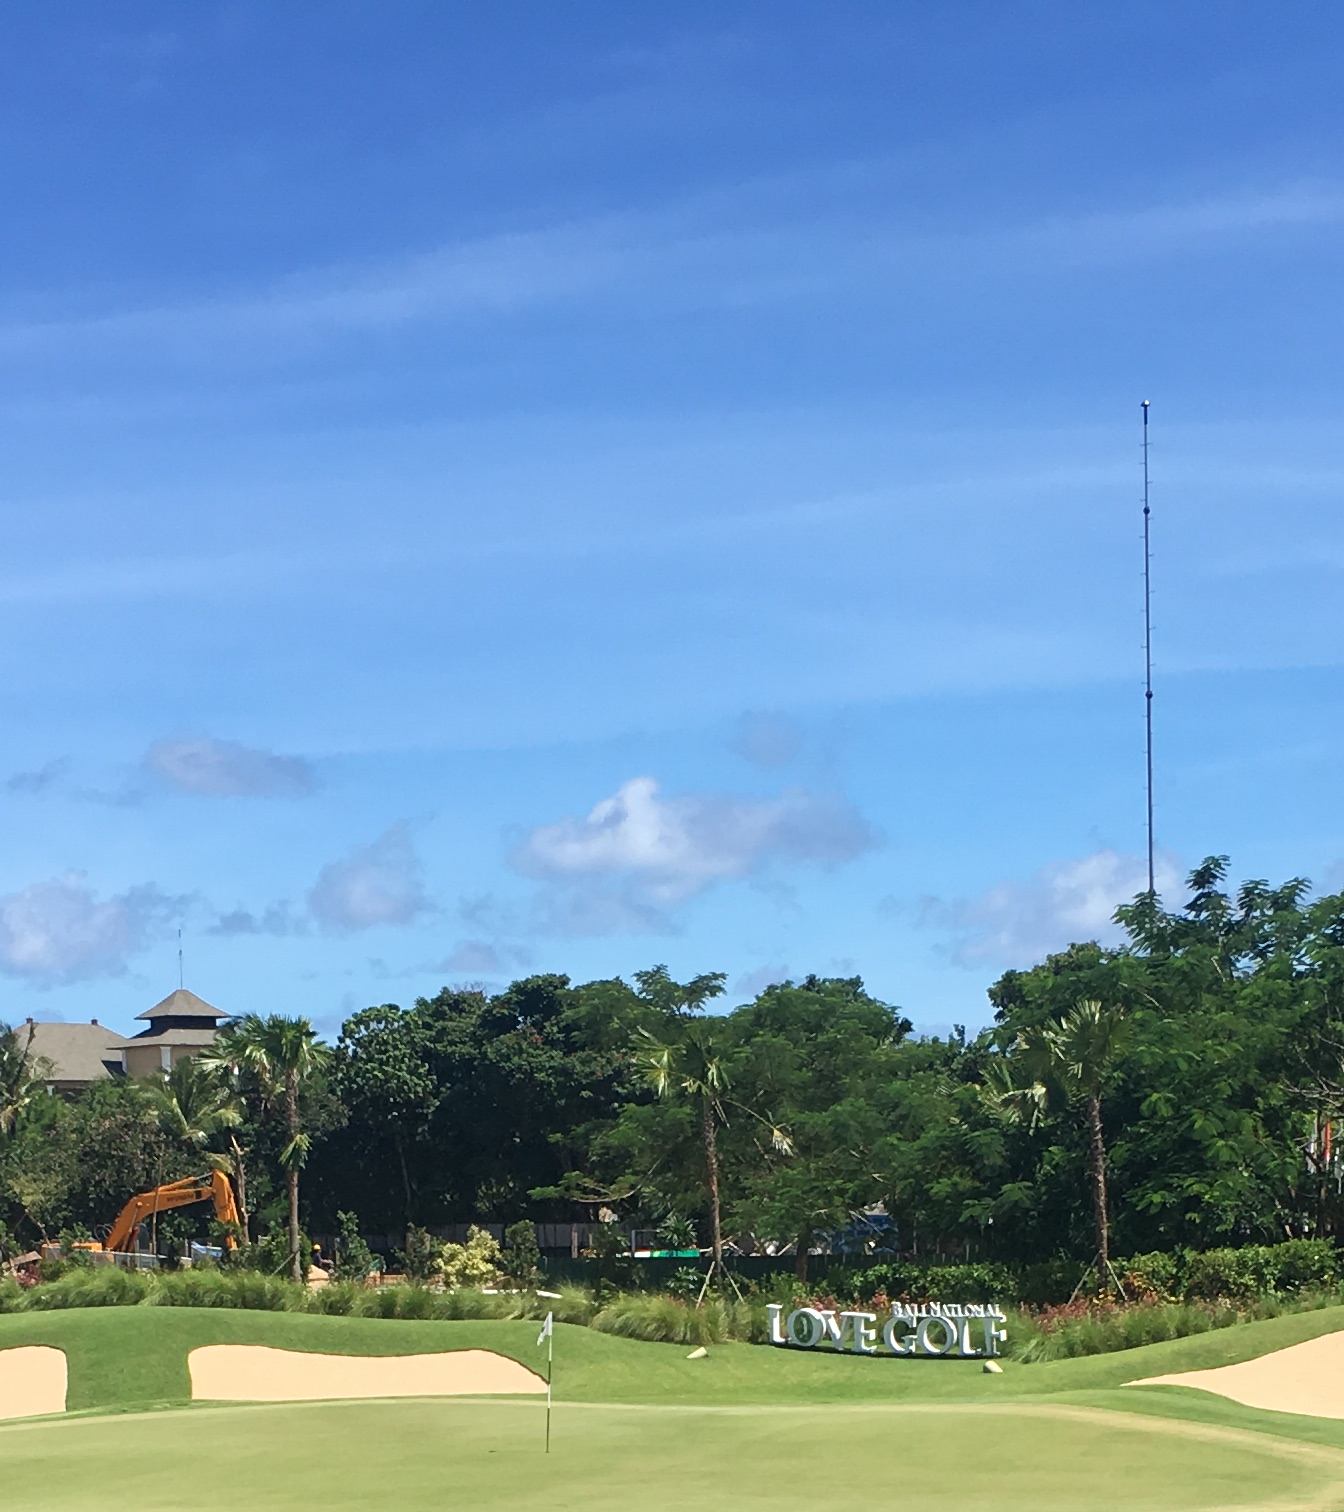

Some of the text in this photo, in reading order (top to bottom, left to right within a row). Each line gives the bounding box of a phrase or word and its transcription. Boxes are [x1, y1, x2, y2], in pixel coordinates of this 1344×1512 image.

[890, 1301, 1002, 1318] BALI NATIONAL
[766, 1303, 1008, 1356] LOVE GOLF
